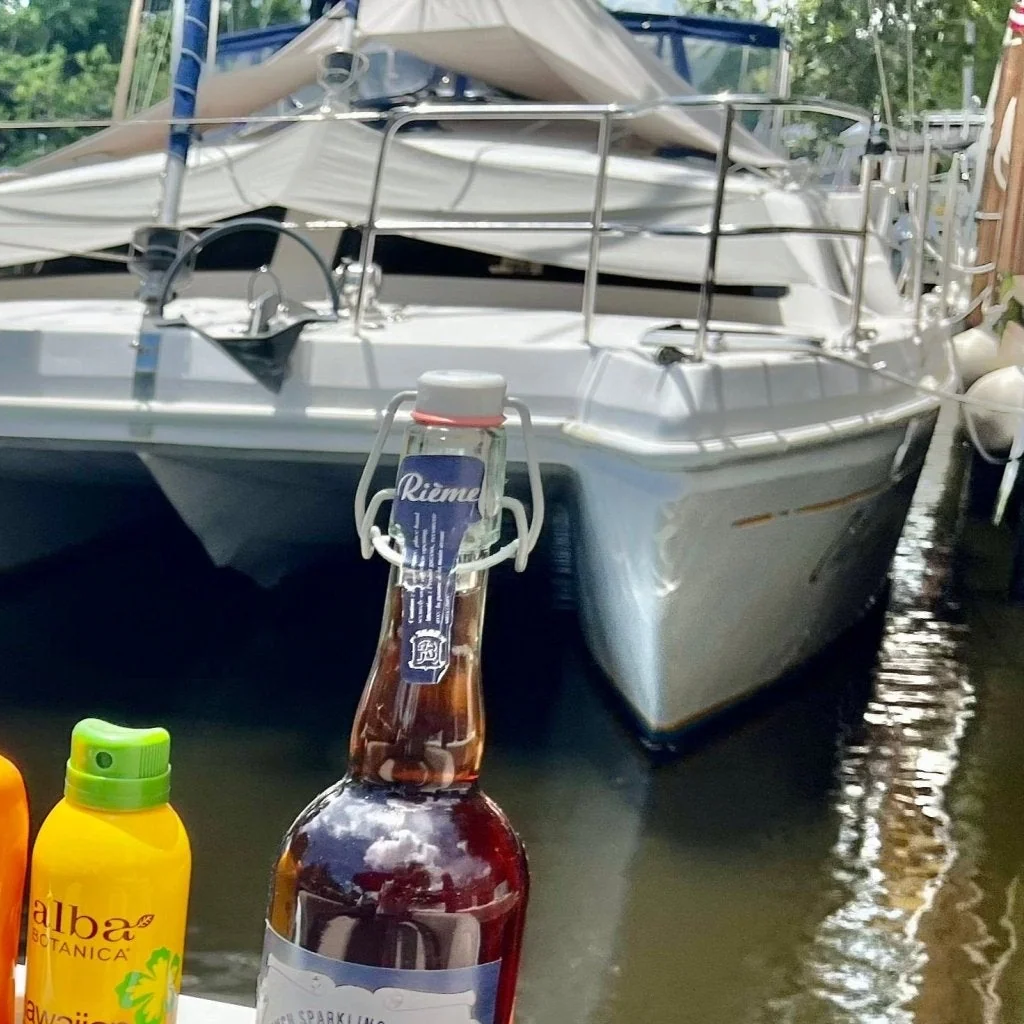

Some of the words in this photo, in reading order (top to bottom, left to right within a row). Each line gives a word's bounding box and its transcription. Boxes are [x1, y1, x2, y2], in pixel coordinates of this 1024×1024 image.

[398, 472, 480, 502] Rième
[33, 899, 135, 942] alba
[32, 927, 129, 961] BOTANICA
